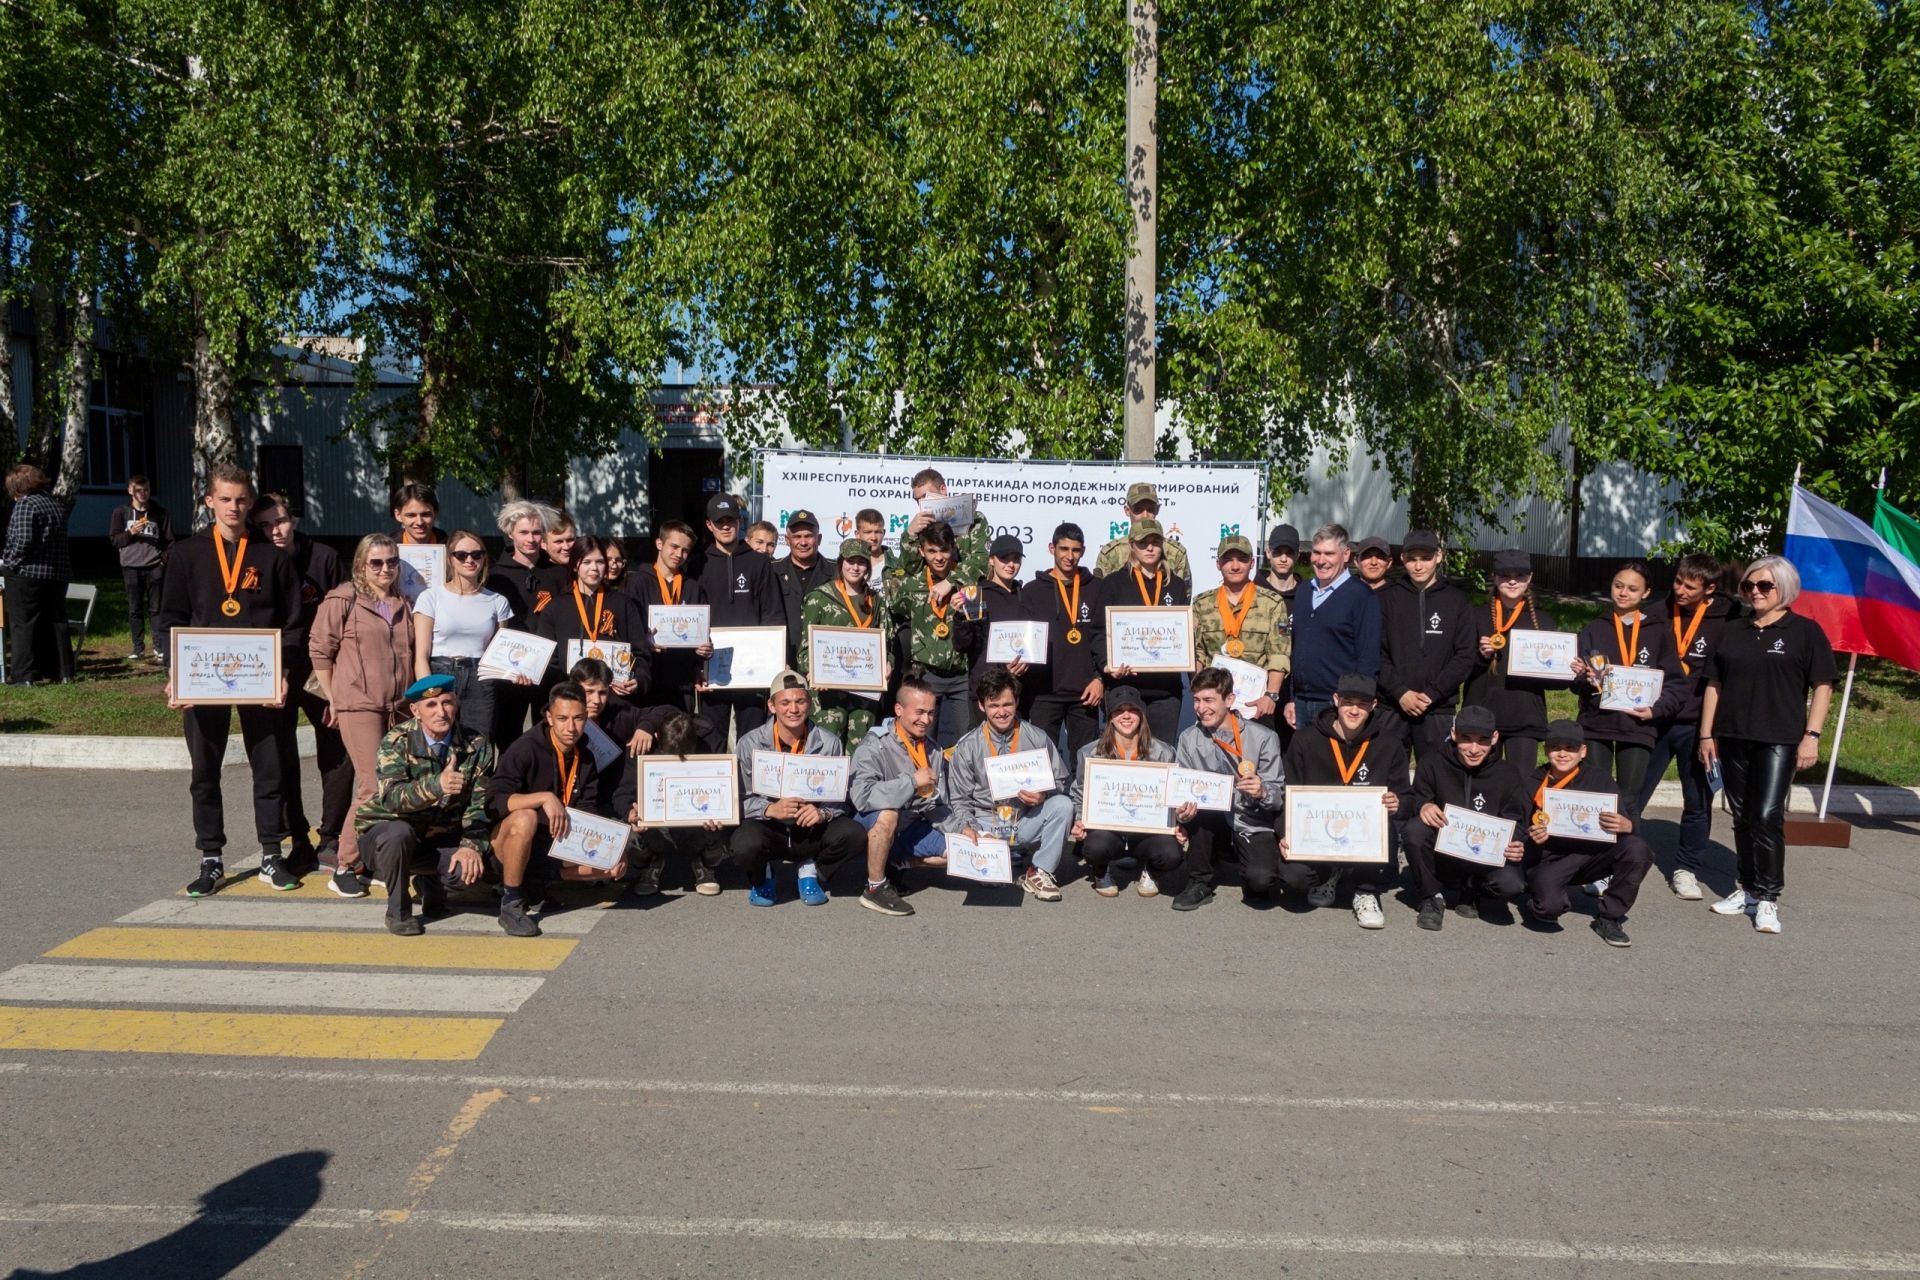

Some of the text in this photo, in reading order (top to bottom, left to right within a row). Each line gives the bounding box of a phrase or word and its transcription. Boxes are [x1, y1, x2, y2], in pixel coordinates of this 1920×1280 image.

[810, 472, 914, 486] РЕСПУБЛИКАНС
[944, 478, 1028, 490] ПАРТАКИАДА
[1032, 481, 1126, 492] МОЛОДЕЖНЫХ
[1151, 482, 1240, 494] МИРОВАНИЙ
[848, 488, 867, 498] ПО
[869, 488, 915, 500] ОХРАН
[1038, 495, 1098, 507] ПОРЯДКА
[1124, 627, 1177, 636] ДИПЛОМ
[824, 645, 871, 656] ДИПЛОМ
[194, 652, 260, 662] ДИПЛОМ
[793, 767, 838, 777] ДИПЛОМ
[677, 788, 722, 796] ДИПЛОМ
[1103, 782, 1159, 794] ДИПЛОМ
[1556, 802, 1604, 814] ДИПЛОМ
[1304, 809, 1367, 820] ДИПЛОМ
[572, 825, 616, 844] ДИПЛОМ
[1453, 821, 1500, 839] ДИПЛОМ
